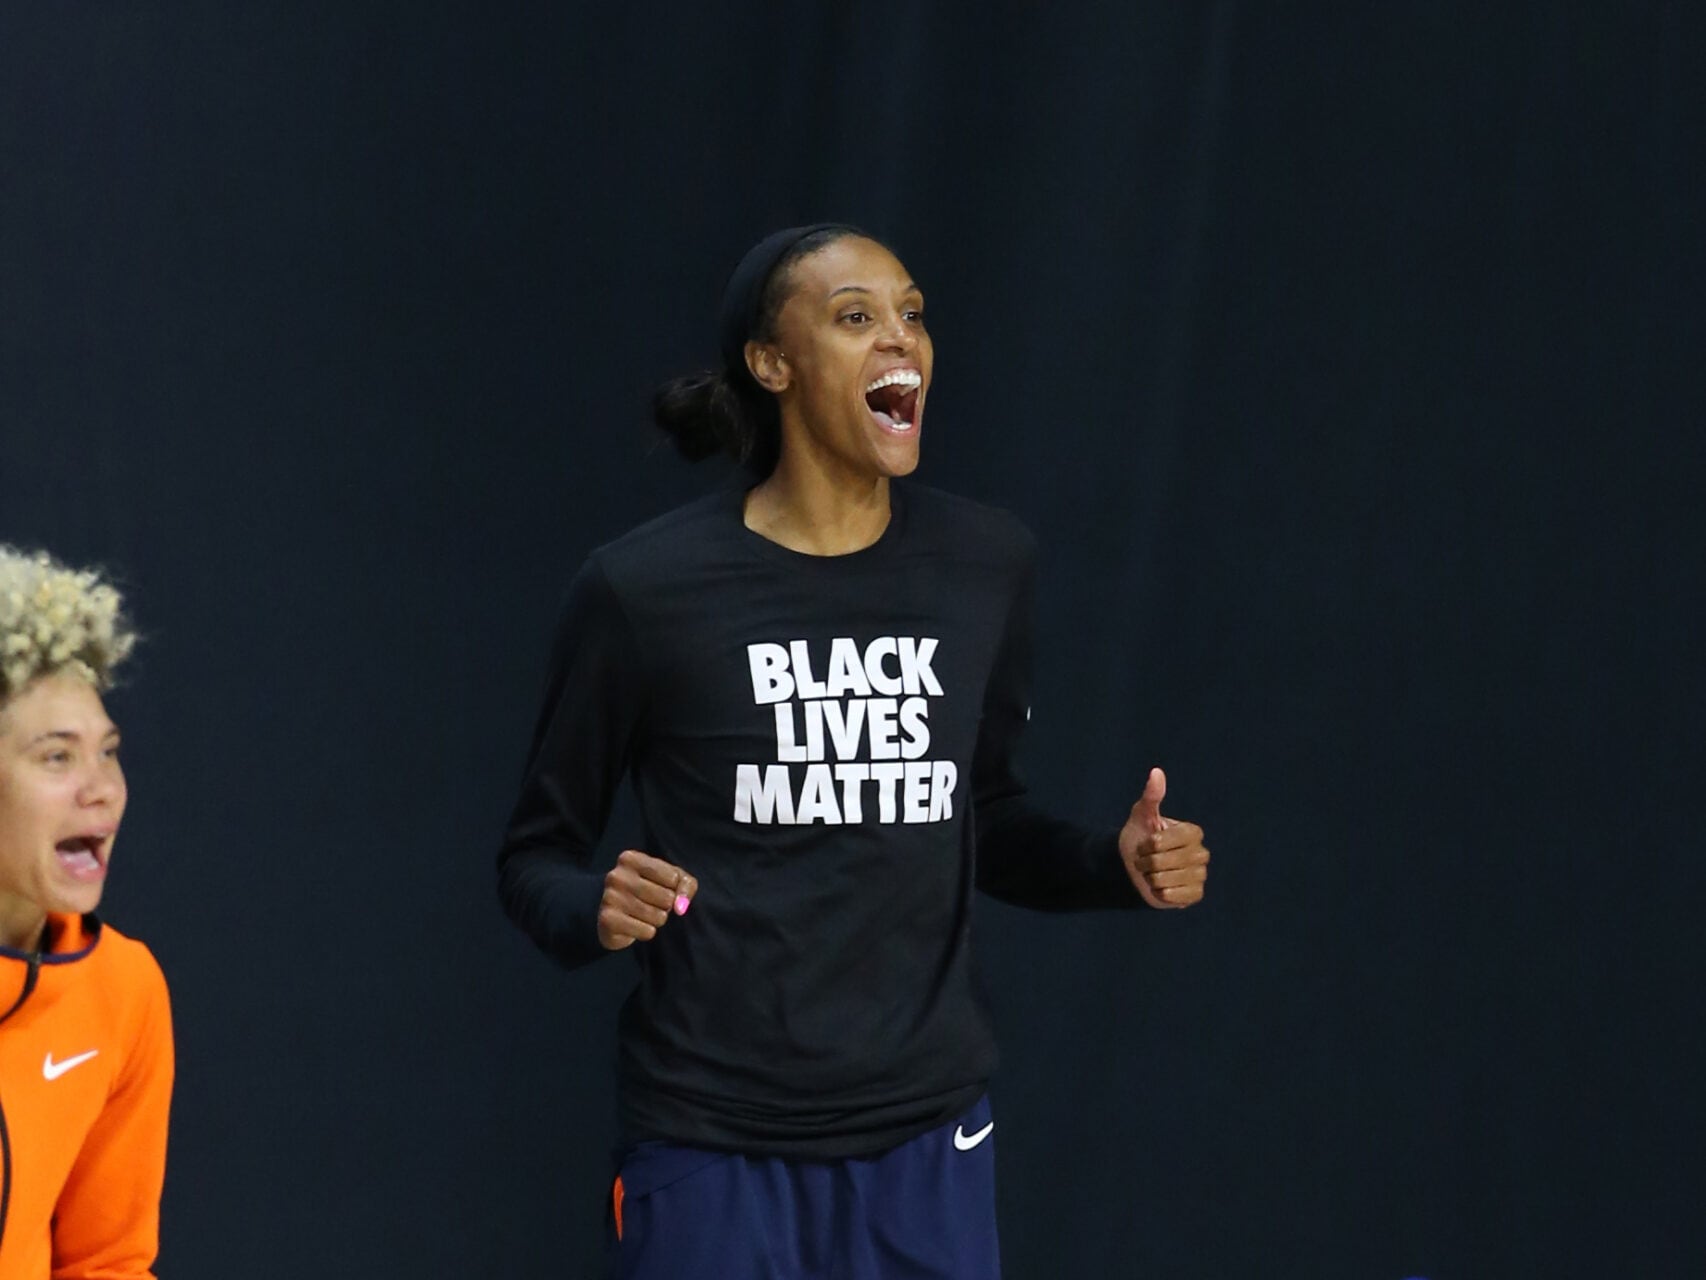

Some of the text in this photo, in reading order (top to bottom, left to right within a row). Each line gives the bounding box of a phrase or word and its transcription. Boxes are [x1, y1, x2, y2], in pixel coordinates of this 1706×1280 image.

[747, 636, 945, 705] BLACK
[774, 697, 932, 762] LIVES
[733, 760, 958, 825] MATTER
